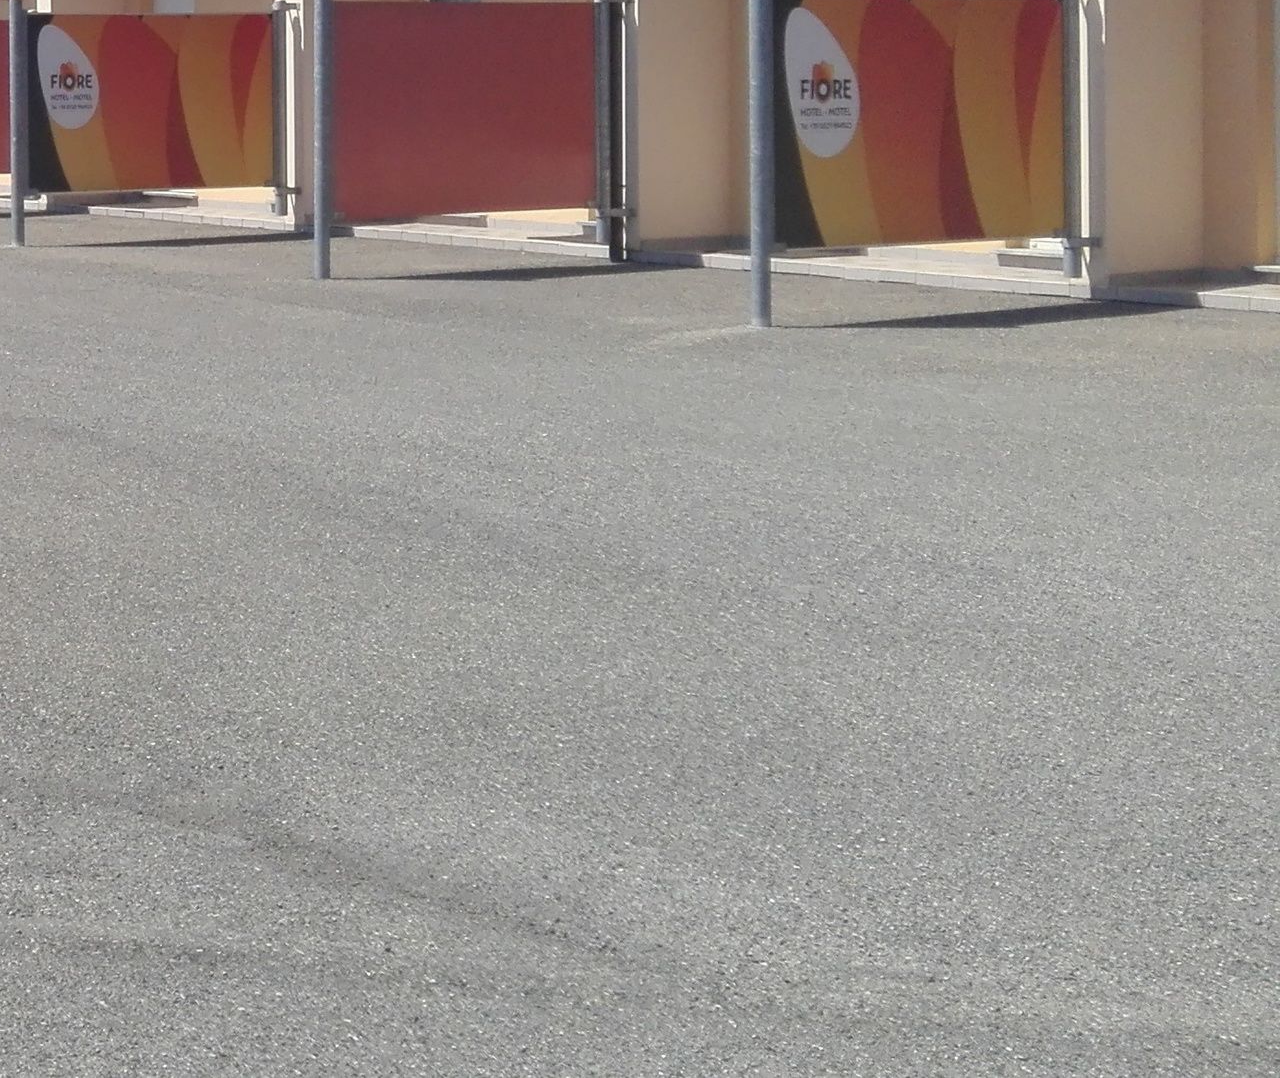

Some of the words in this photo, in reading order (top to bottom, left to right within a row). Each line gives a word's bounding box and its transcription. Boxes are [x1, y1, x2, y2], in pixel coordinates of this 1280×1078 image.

[50, 74, 93, 90] FIORE
[800, 79, 852, 102] FIORE
[800, 107, 824, 117] HOTEL
[827, 107, 852, 116] MOTEL
